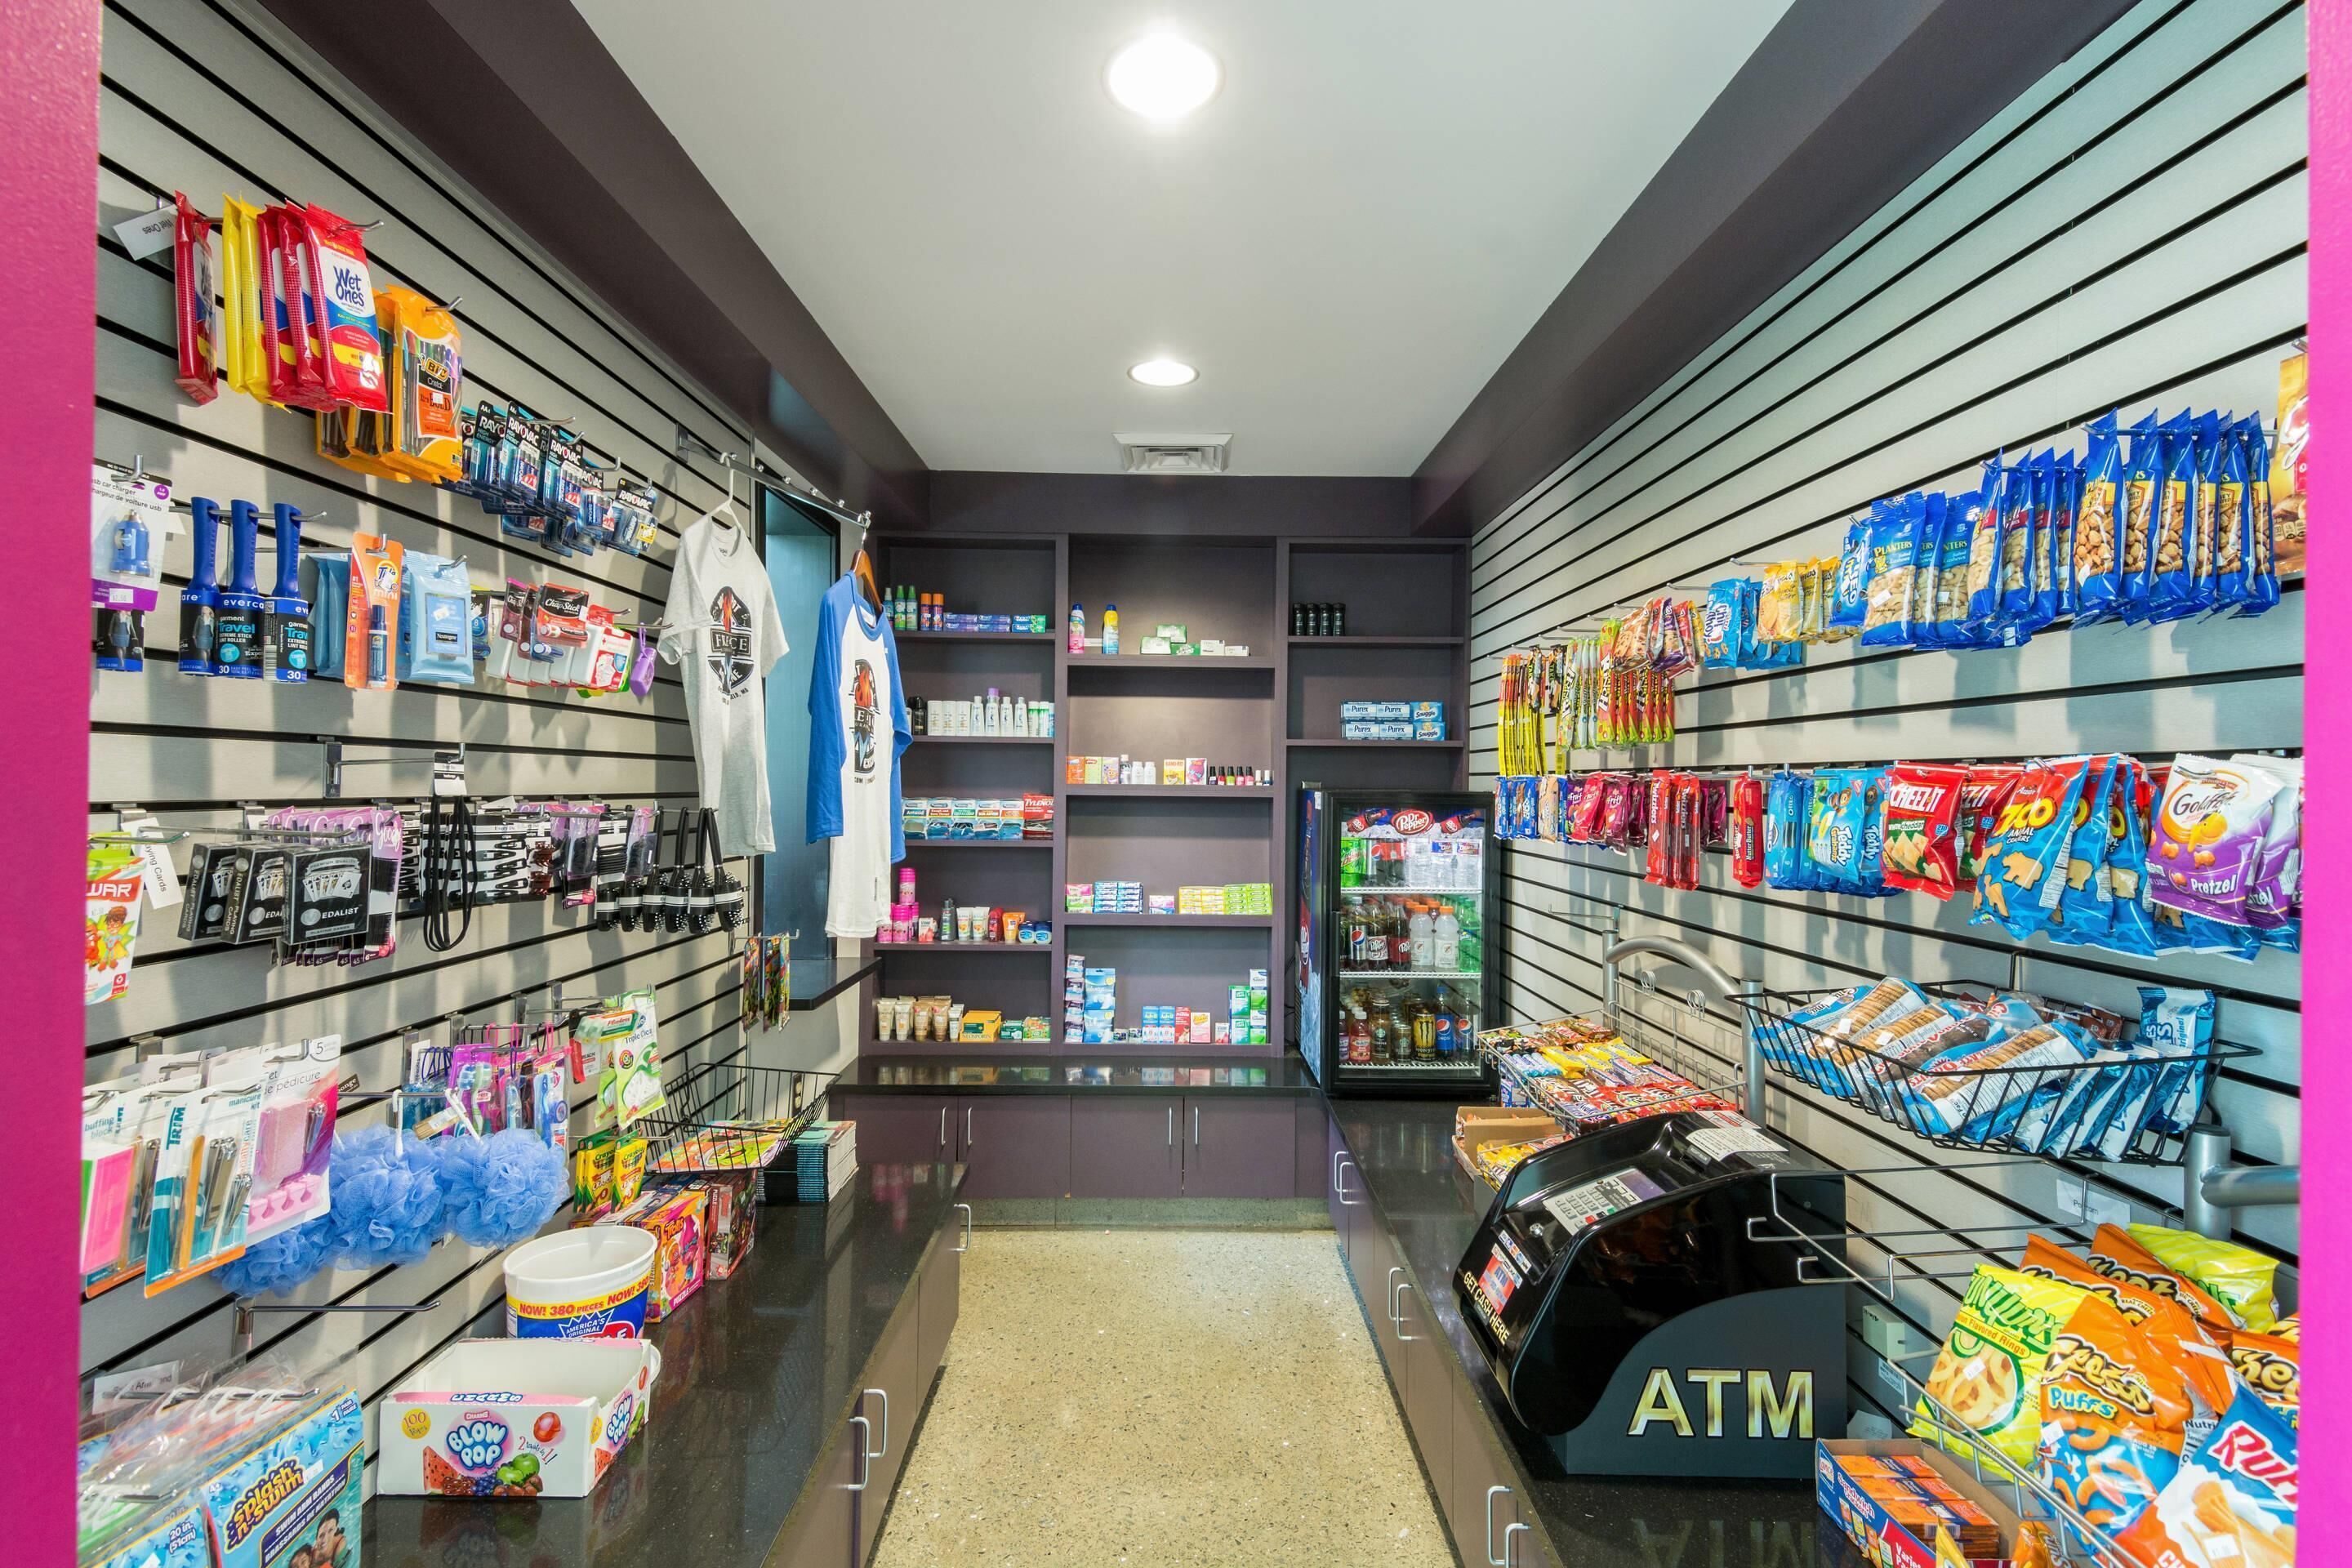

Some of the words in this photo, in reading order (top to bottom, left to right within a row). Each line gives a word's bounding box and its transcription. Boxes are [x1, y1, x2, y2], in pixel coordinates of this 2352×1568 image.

[142, 223, 162, 234] Ones
[160, 218, 174, 229] Wet
[333, 265, 362, 292] Wet
[335, 284, 365, 307] Ones
[508, 416, 539, 447] RAYOVAC
[550, 439, 581, 466] RAYOVAC
[112, 484, 136, 495] charger
[125, 499, 148, 508] voiture
[618, 489, 653, 510] RAYOVAC
[1874, 541, 1913, 557] PLANTERS
[372, 588, 398, 600] mini
[545, 598, 581, 612] ChapStick
[218, 622, 256, 634] Travel
[218, 665, 230, 674] 30
[287, 670, 301, 679] 30
[1352, 705, 1369, 713] Purex
[1384, 705, 1401, 713] Purex
[1415, 710, 1437, 719] Snuggle
[1354, 725, 1371, 733] Purex
[1388, 725, 1405, 733] Purex
[1418, 730, 1439, 738] Snuggle
[1024, 798, 1054, 806] TYLENOL
[1650, 781, 1661, 824] Twizzlers
[1889, 783, 1946, 813] CHEEZ-IT
[1399, 817, 1427, 831] Pepper
[1408, 813, 1420, 823] Dr
[1900, 819, 1926, 831] cheddar
[1993, 796, 2055, 837] ZOO
[1936, 824, 1948, 832] 210
[1838, 826, 1853, 866] Teddy
[1864, 823, 1880, 862] Teddy
[154, 866, 167, 893] Cards
[2190, 874, 2238, 895] Pretzel
[315, 1042, 323, 1055] 5
[274, 1071, 321, 1093] pédicure
[229, 1093, 262, 1107] manicure
[250, 1101, 261, 1111] kit
[84, 1116, 114, 1133] buffing
[91, 1126, 114, 1139] block
[166, 1107, 186, 1151] TRIM
[1494, 1266, 1508, 1285] ATM
[519, 1303, 546, 1316] NOW!
[550, 1303, 575, 1316] 380
[576, 1301, 604, 1313] PIECES
[607, 1285, 635, 1306] NOW!
[1463, 1271, 1479, 1294] GET
[1473, 1288, 1494, 1318] CASH
[1489, 1313, 1511, 1347] HERE
[566, 1317, 606, 1335] AMERICA'S
[1967, 1317, 1998, 1341] Flavored
[1998, 1334, 2026, 1356] Rings
[330, 1408, 340, 1422] 1
[340, 1399, 353, 1411] PAIR
[1627, 1367, 1815, 1439] ATM
[403, 1411, 427, 1429] 100
[607, 1394, 632, 1439] BLOW
[448, 1419, 509, 1454] BLOW
[613, 1412, 630, 1445] POP
[517, 1436, 527, 1451] 2
[459, 1443, 503, 1468] POP
[234, 1466, 295, 1528] splash
[1838, 1472, 1876, 1519] Sandwich
[275, 1509, 297, 1537] SWIM
[312, 1475, 336, 1501] BANDS
[169, 1527, 182, 1539] 20
